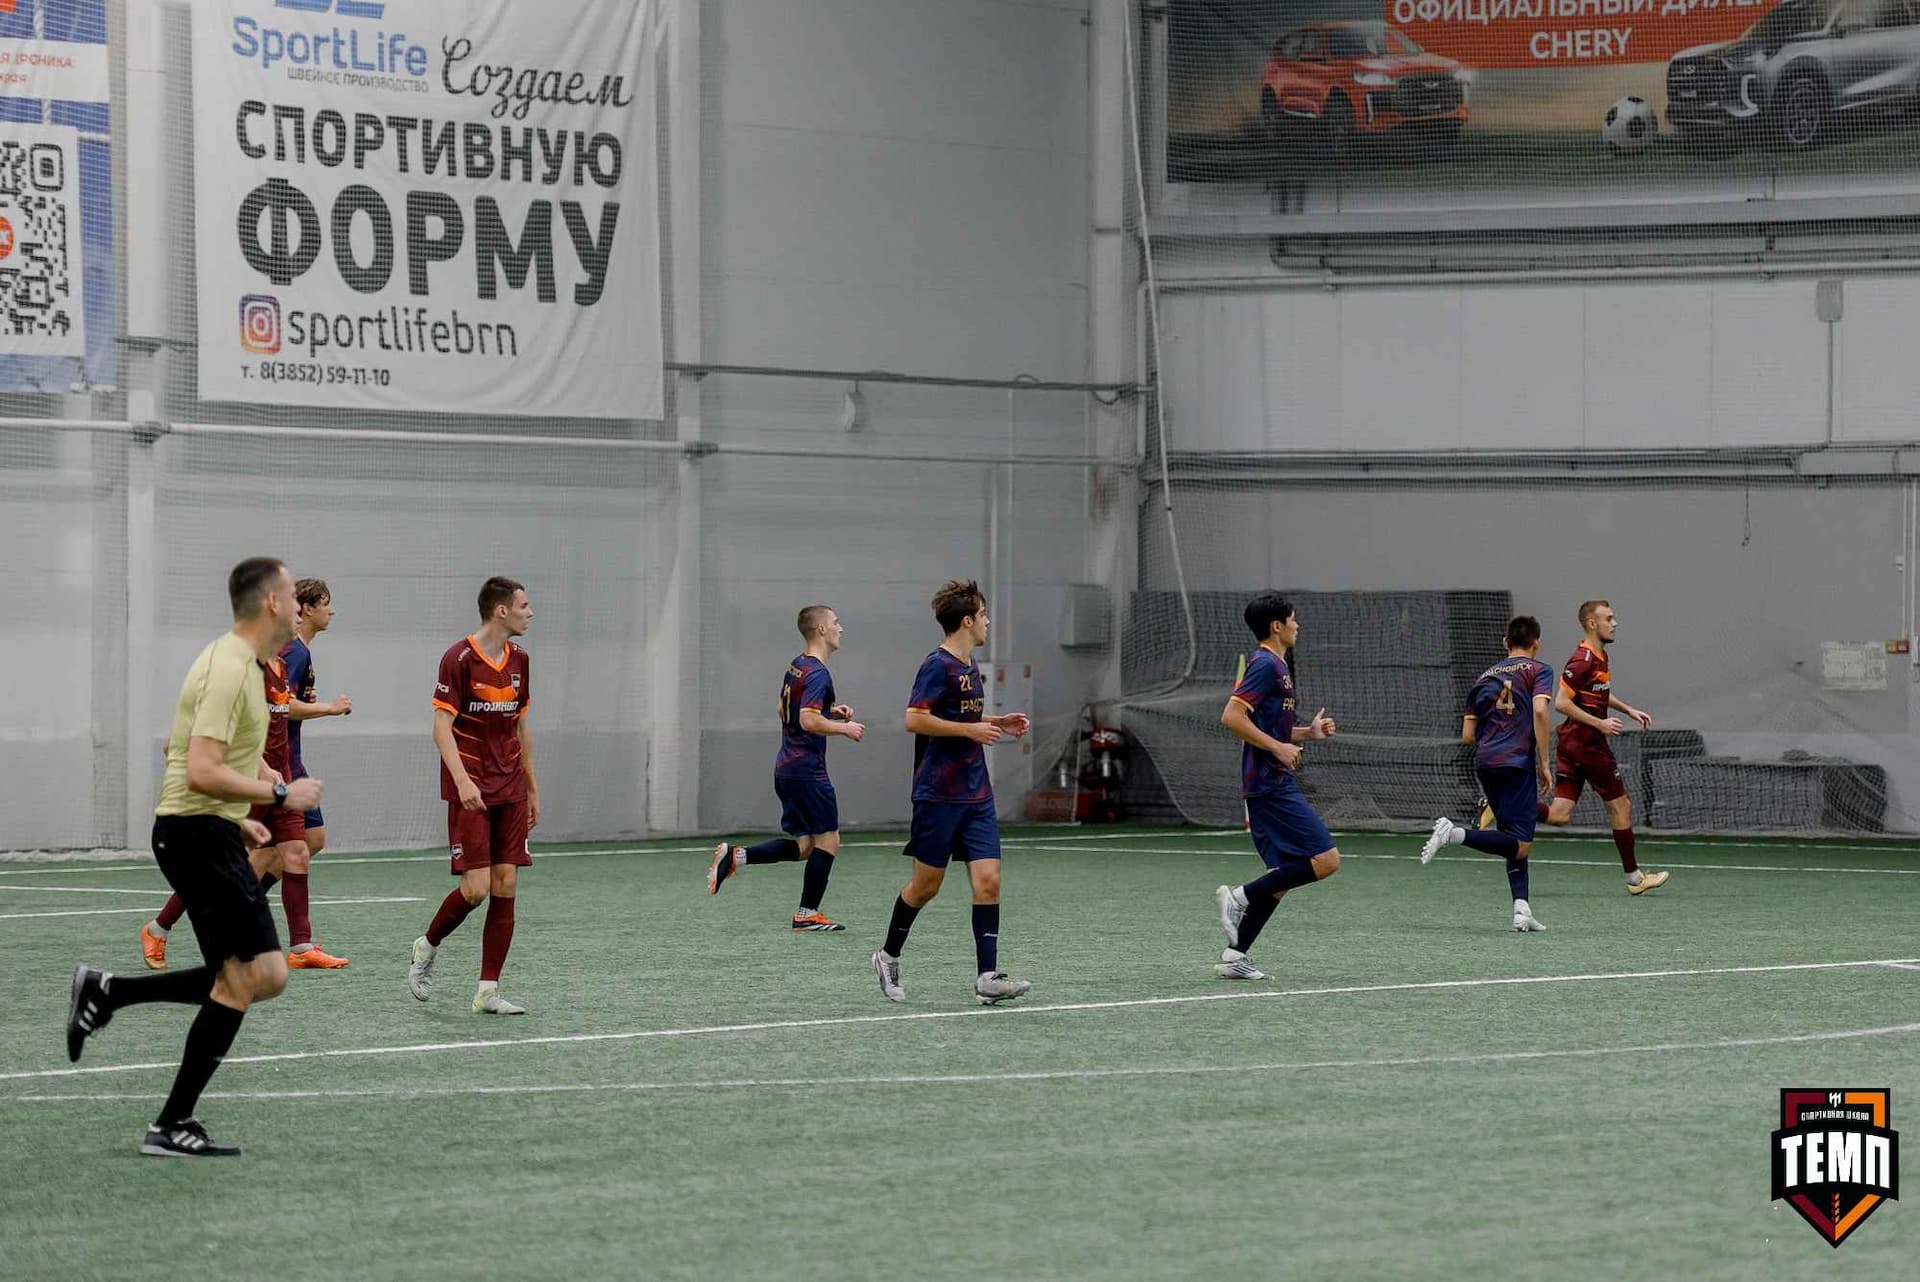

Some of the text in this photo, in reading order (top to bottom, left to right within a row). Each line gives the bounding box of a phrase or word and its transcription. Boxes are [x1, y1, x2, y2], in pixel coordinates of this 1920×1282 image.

[232, 15, 428, 76] SportLife
[1530, 27, 1632, 60] CHERY
[441, 34, 634, 120] Создаем
[236, 100, 622, 188] СПОРТИВНУЮ
[237, 177, 620, 306] ФОРМУ
[287, 305, 518, 358] sportlifebrn
[260, 361, 323, 386] 8(3852)
[326, 366, 391, 386] 59-11-10
[1496, 680, 1515, 715] 4
